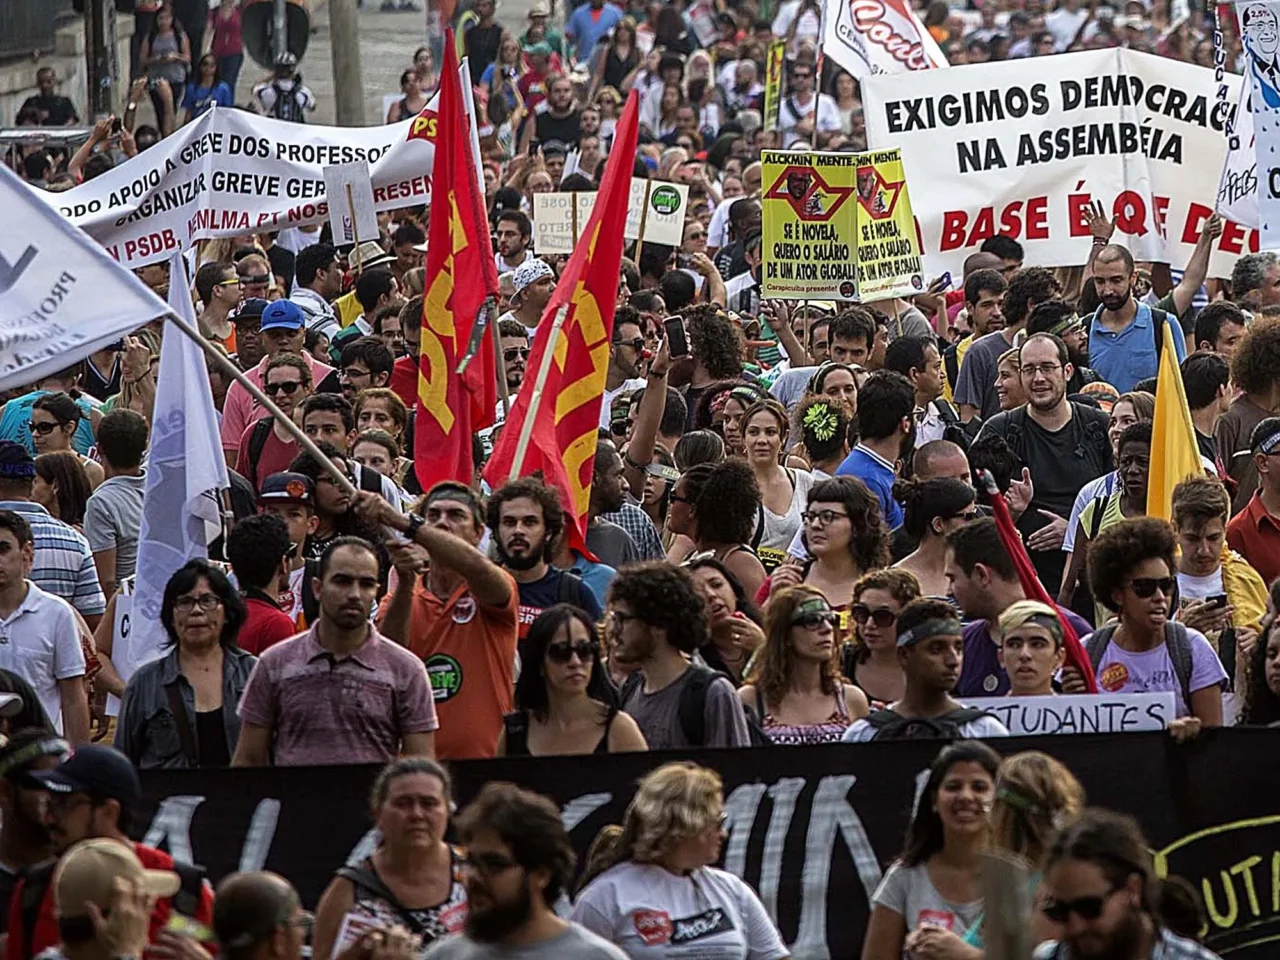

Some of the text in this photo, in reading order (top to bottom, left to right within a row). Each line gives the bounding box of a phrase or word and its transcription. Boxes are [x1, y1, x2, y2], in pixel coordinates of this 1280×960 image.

[885, 83, 1049, 134] EXIGIMOS
[763, 154, 812, 166] ALCKMIN
[957, 138, 1006, 174] NA
[108, 169, 161, 209] APOIO
[165, 157, 177, 176] A
[180, 132, 224, 165] GREVE
[228, 134, 270, 159] DOS
[212, 170, 280, 197] GREVE
[288, 203, 328, 222] NOS
[939, 195, 1050, 253] BASE
[1068, 180, 1094, 238] É
[784, 220, 839, 242] SE É NOVELA,
[862, 225, 869, 241] SE
[870, 221, 875, 240] É
[773, 239, 849, 261] QUERO O SALÁRIO
[857, 238, 912, 263] QUERO O SALÁRIO
[767, 263, 778, 279] DE
[780, 263, 793, 279] UM
[795, 263, 818, 280] ATOR
[857, 267, 866, 283] DE
[866, 265, 875, 281] UM
[878, 261, 894, 279] ATOR
